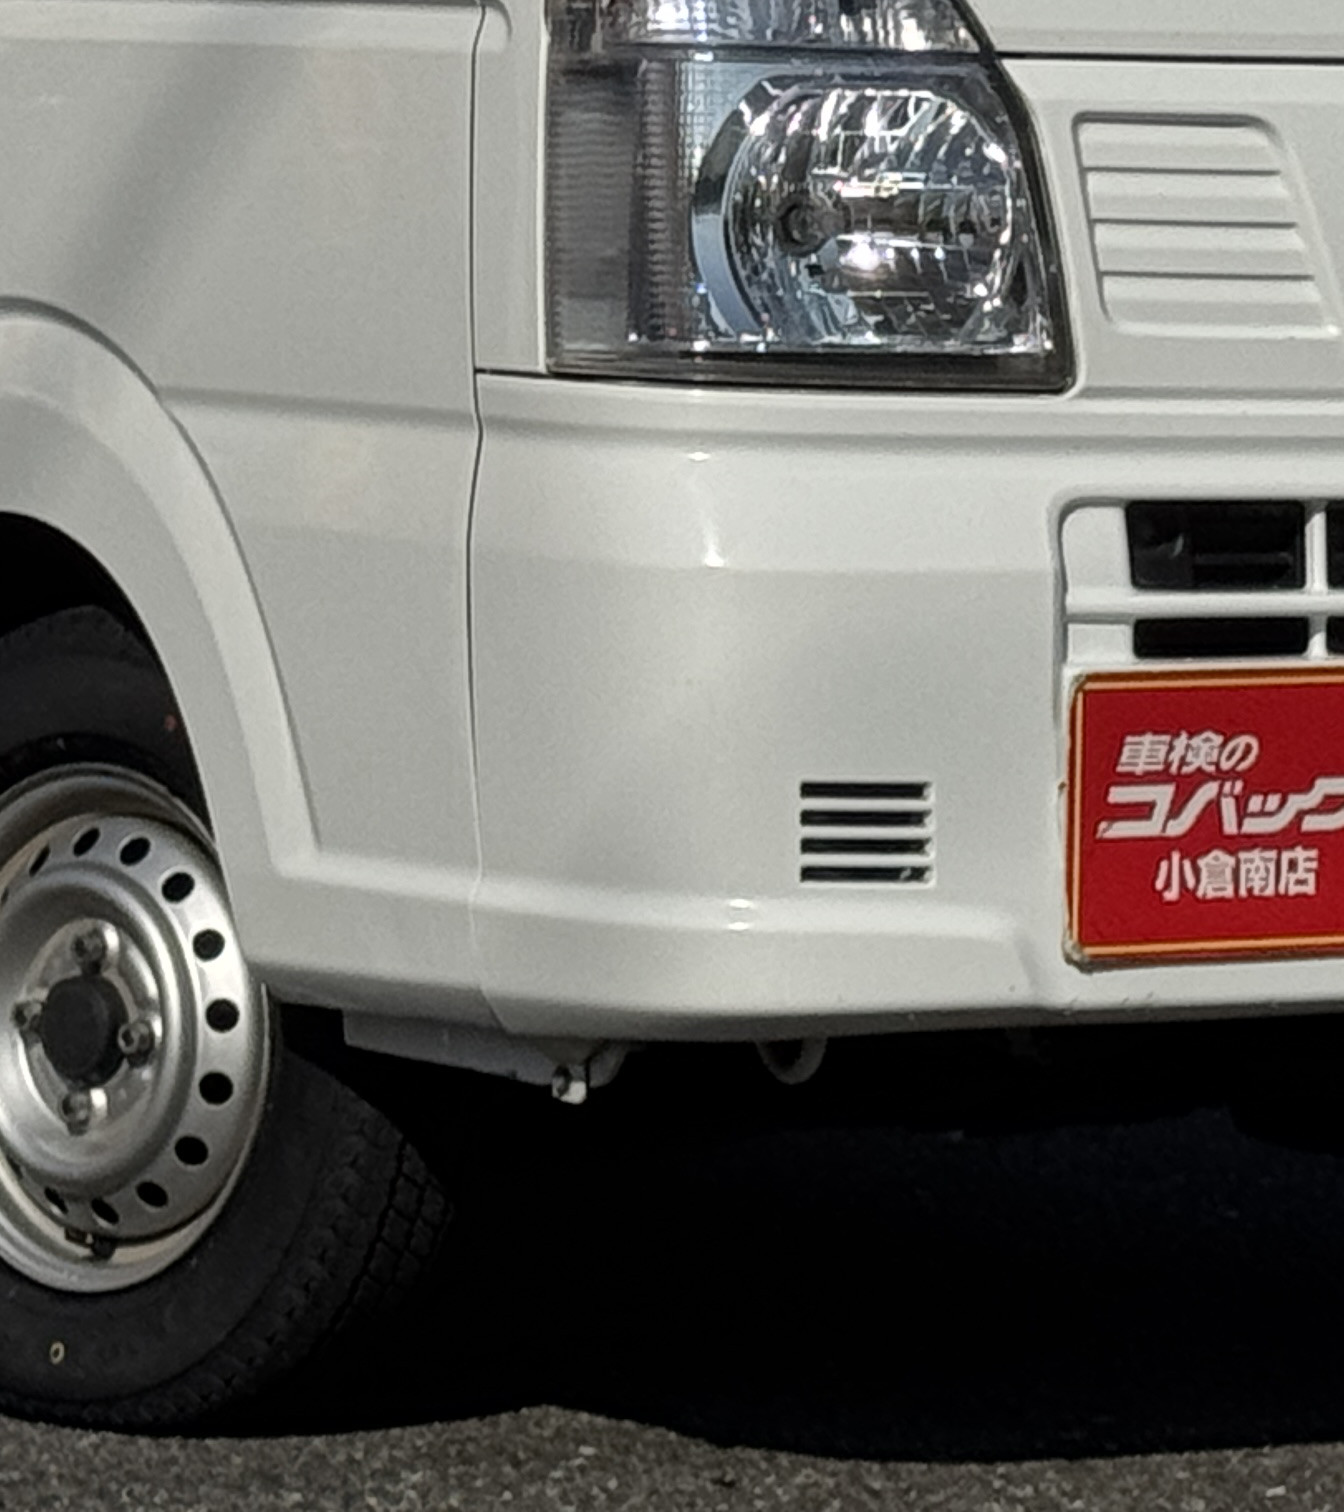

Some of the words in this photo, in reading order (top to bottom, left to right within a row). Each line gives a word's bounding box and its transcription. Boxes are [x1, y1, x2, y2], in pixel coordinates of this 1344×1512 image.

[1115, 730, 1260, 775] 車検の
[1154, 846, 1319, 902] 小倉南店
